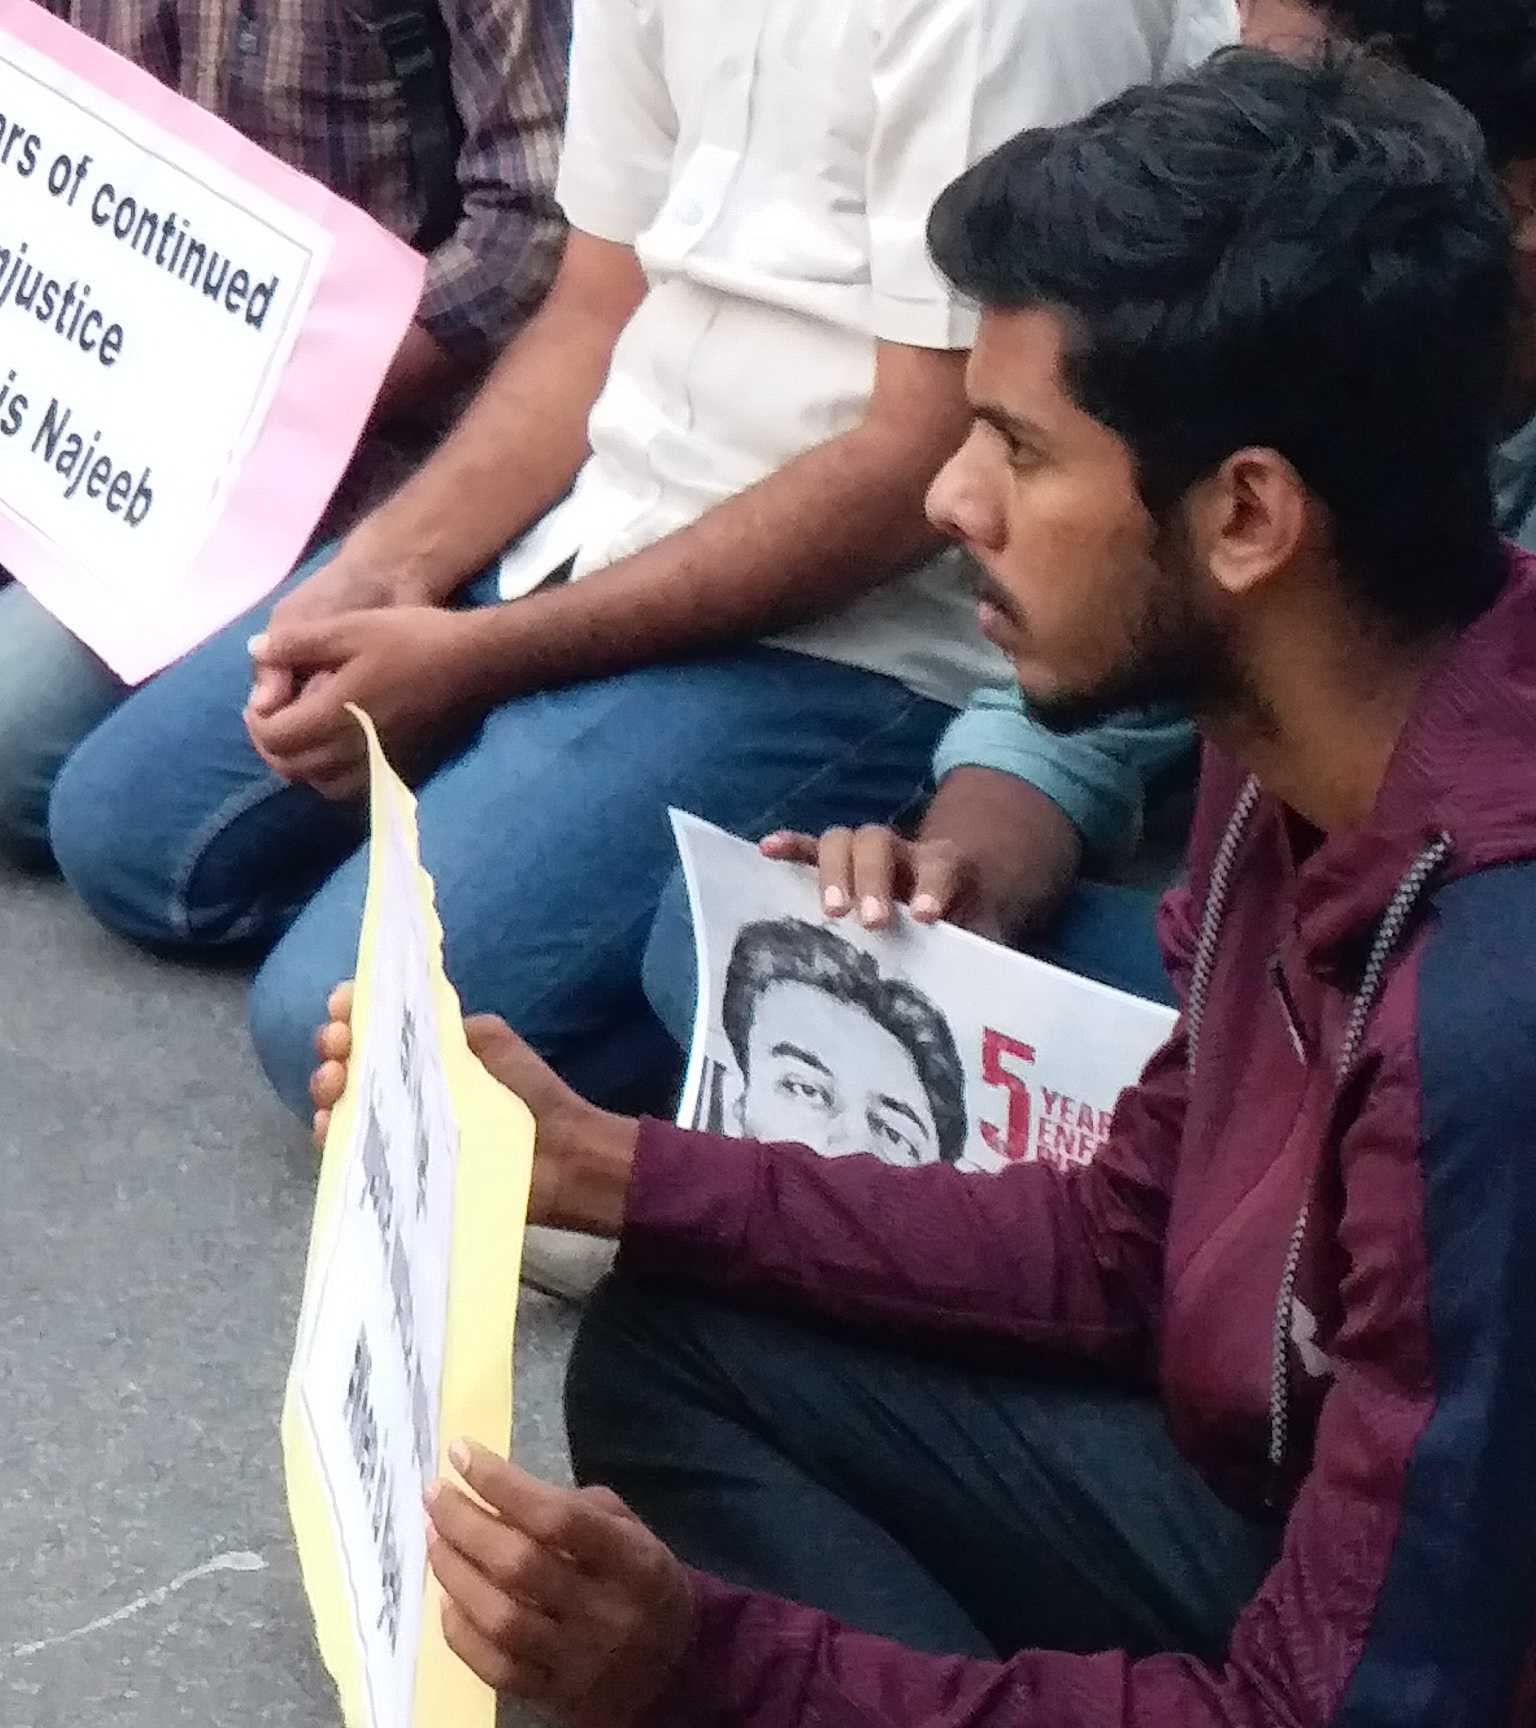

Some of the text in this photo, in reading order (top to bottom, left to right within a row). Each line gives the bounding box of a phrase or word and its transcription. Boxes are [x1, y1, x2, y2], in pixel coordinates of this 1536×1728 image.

[48, 153, 93, 207] of
[90, 181, 279, 331] continued
[30, 397, 154, 529] Najeeb
[980, 1026, 1036, 1161] 5
[1041, 1085, 1115, 1140] YEAR
